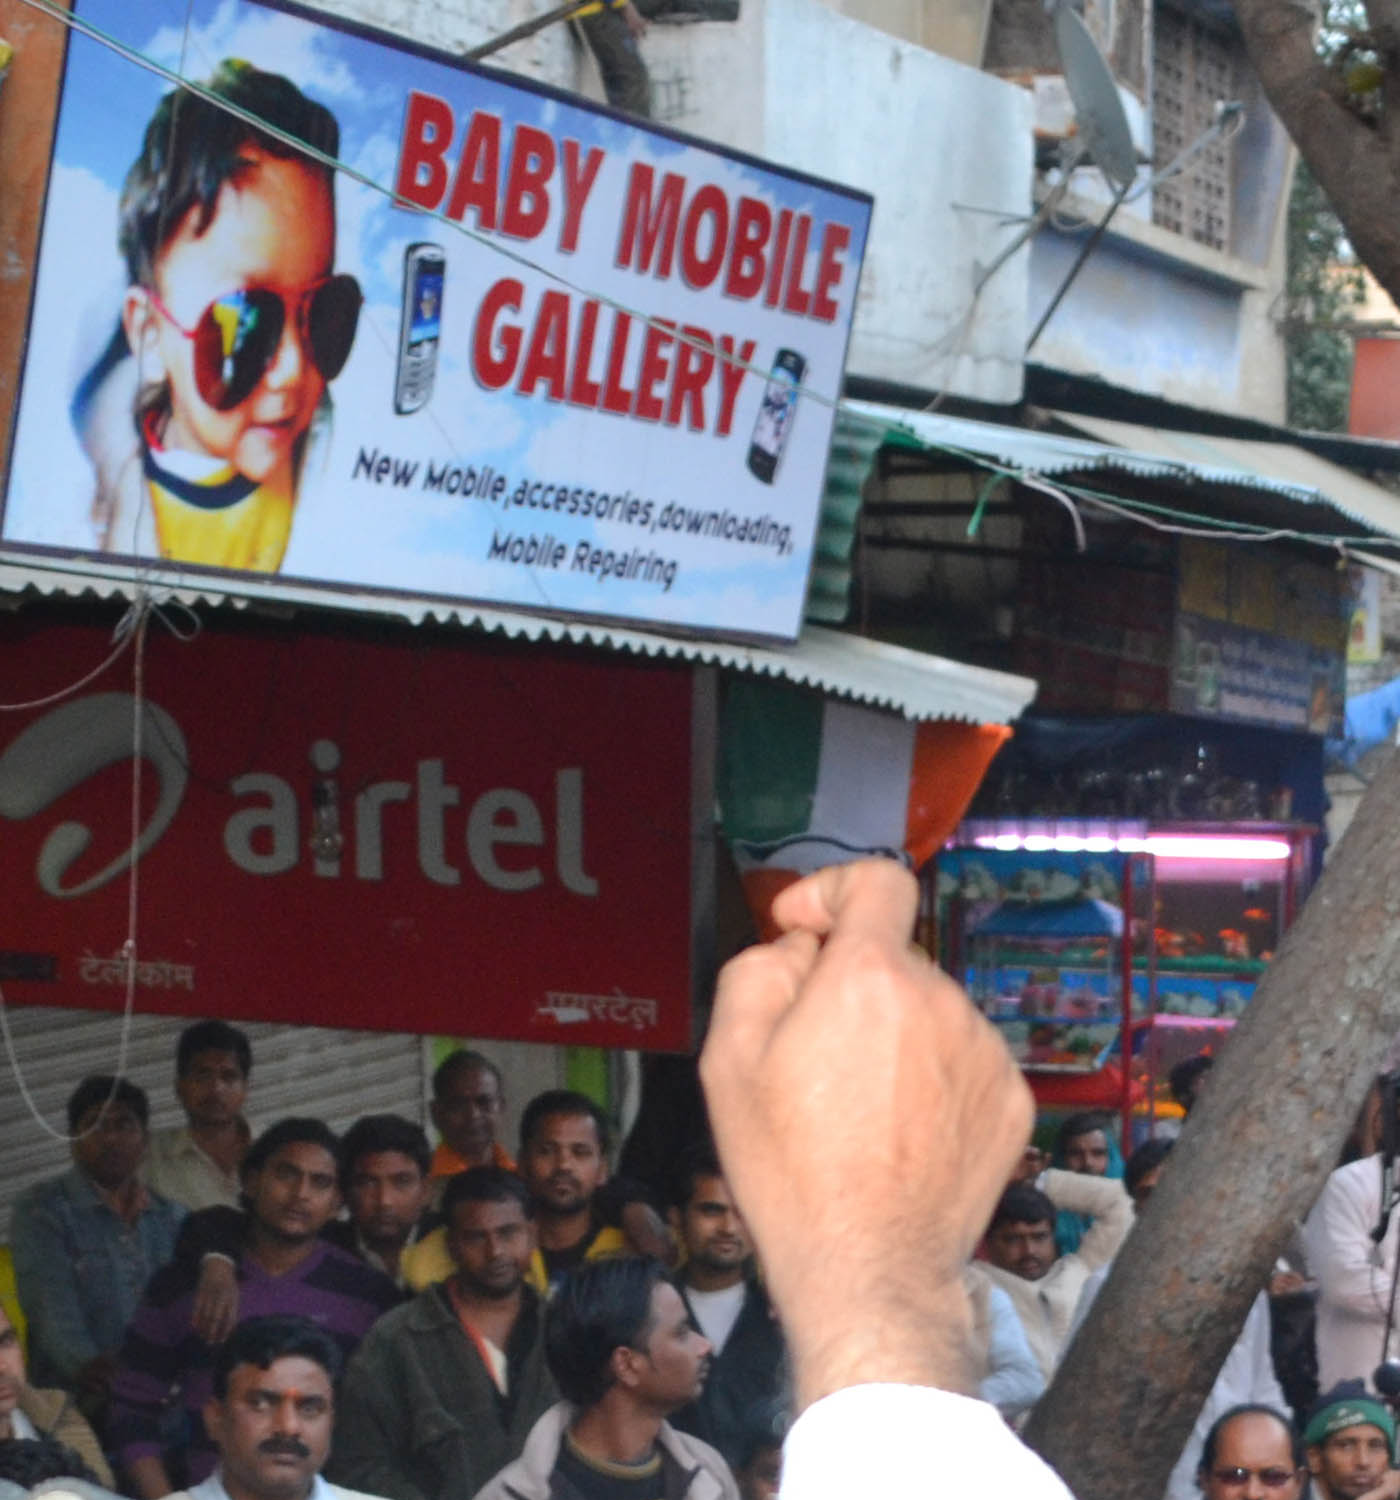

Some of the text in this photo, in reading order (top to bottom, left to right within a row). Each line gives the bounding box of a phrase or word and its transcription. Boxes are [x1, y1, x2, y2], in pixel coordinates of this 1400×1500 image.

[391, 89, 852, 323] BABY MOBILE
[471, 276, 757, 437] GALLERY
[351, 447, 419, 488] New
[487, 529, 679, 593] Mobile Repairing
[222, 738, 598, 896] airtel
